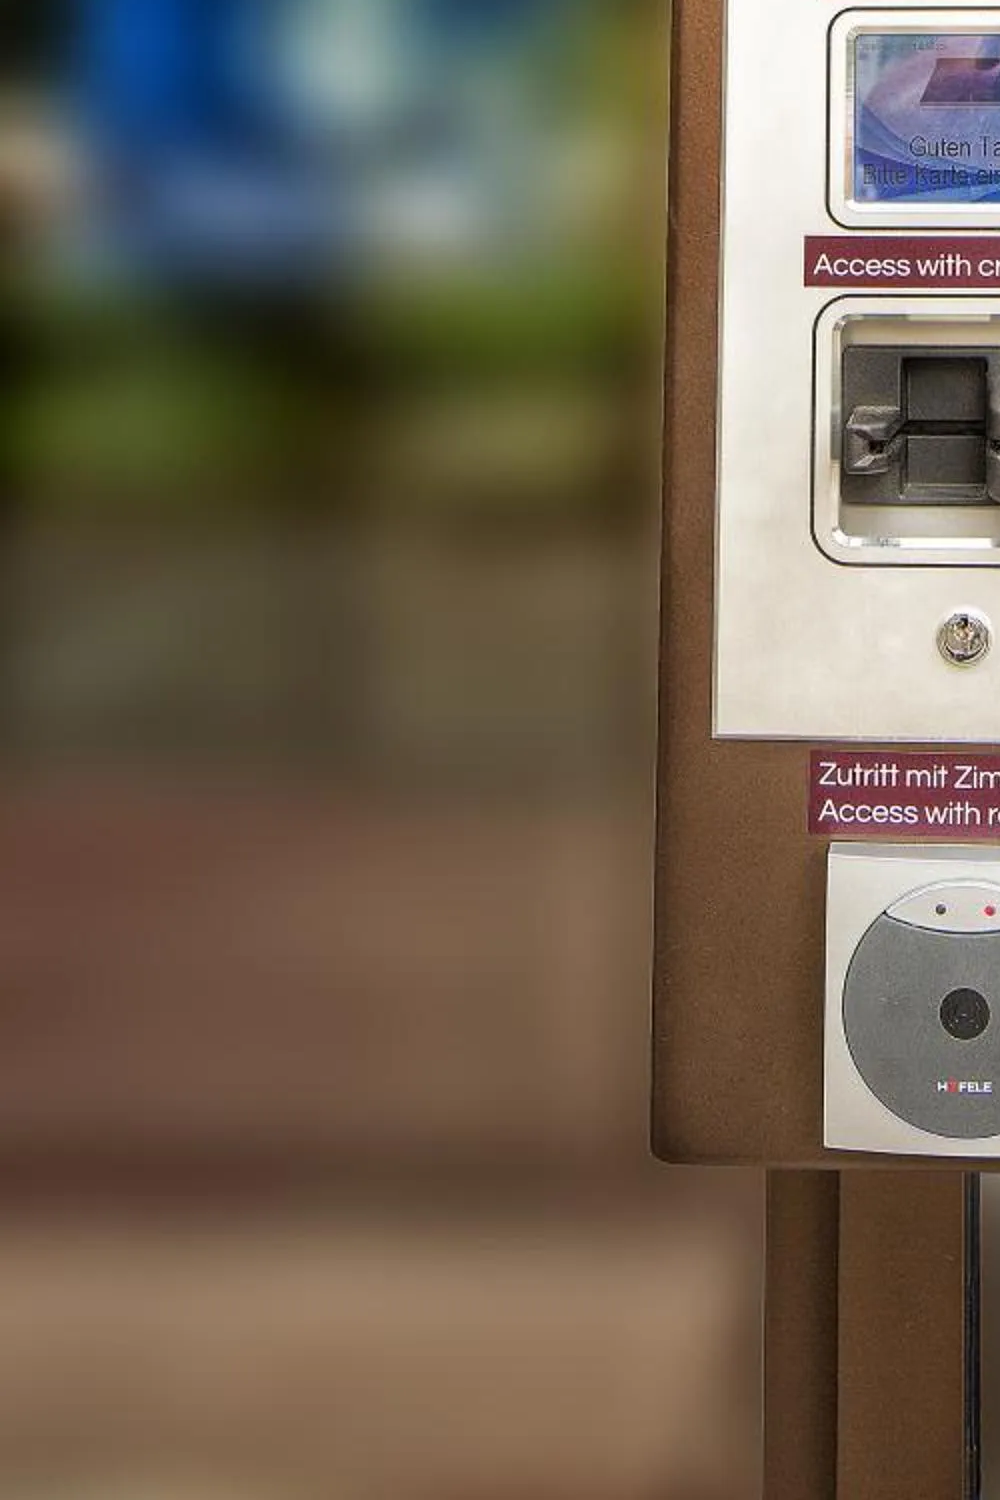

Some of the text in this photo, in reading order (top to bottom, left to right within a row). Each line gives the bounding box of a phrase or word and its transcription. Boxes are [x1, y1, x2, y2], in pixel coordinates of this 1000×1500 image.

[909, 136, 971, 157] Guten
[813, 254, 911, 276] Access
[916, 254, 971, 276] with
[819, 763, 899, 787] Zutritt
[906, 765, 949, 788] mit
[818, 800, 919, 824] Access
[925, 802, 980, 825] with
